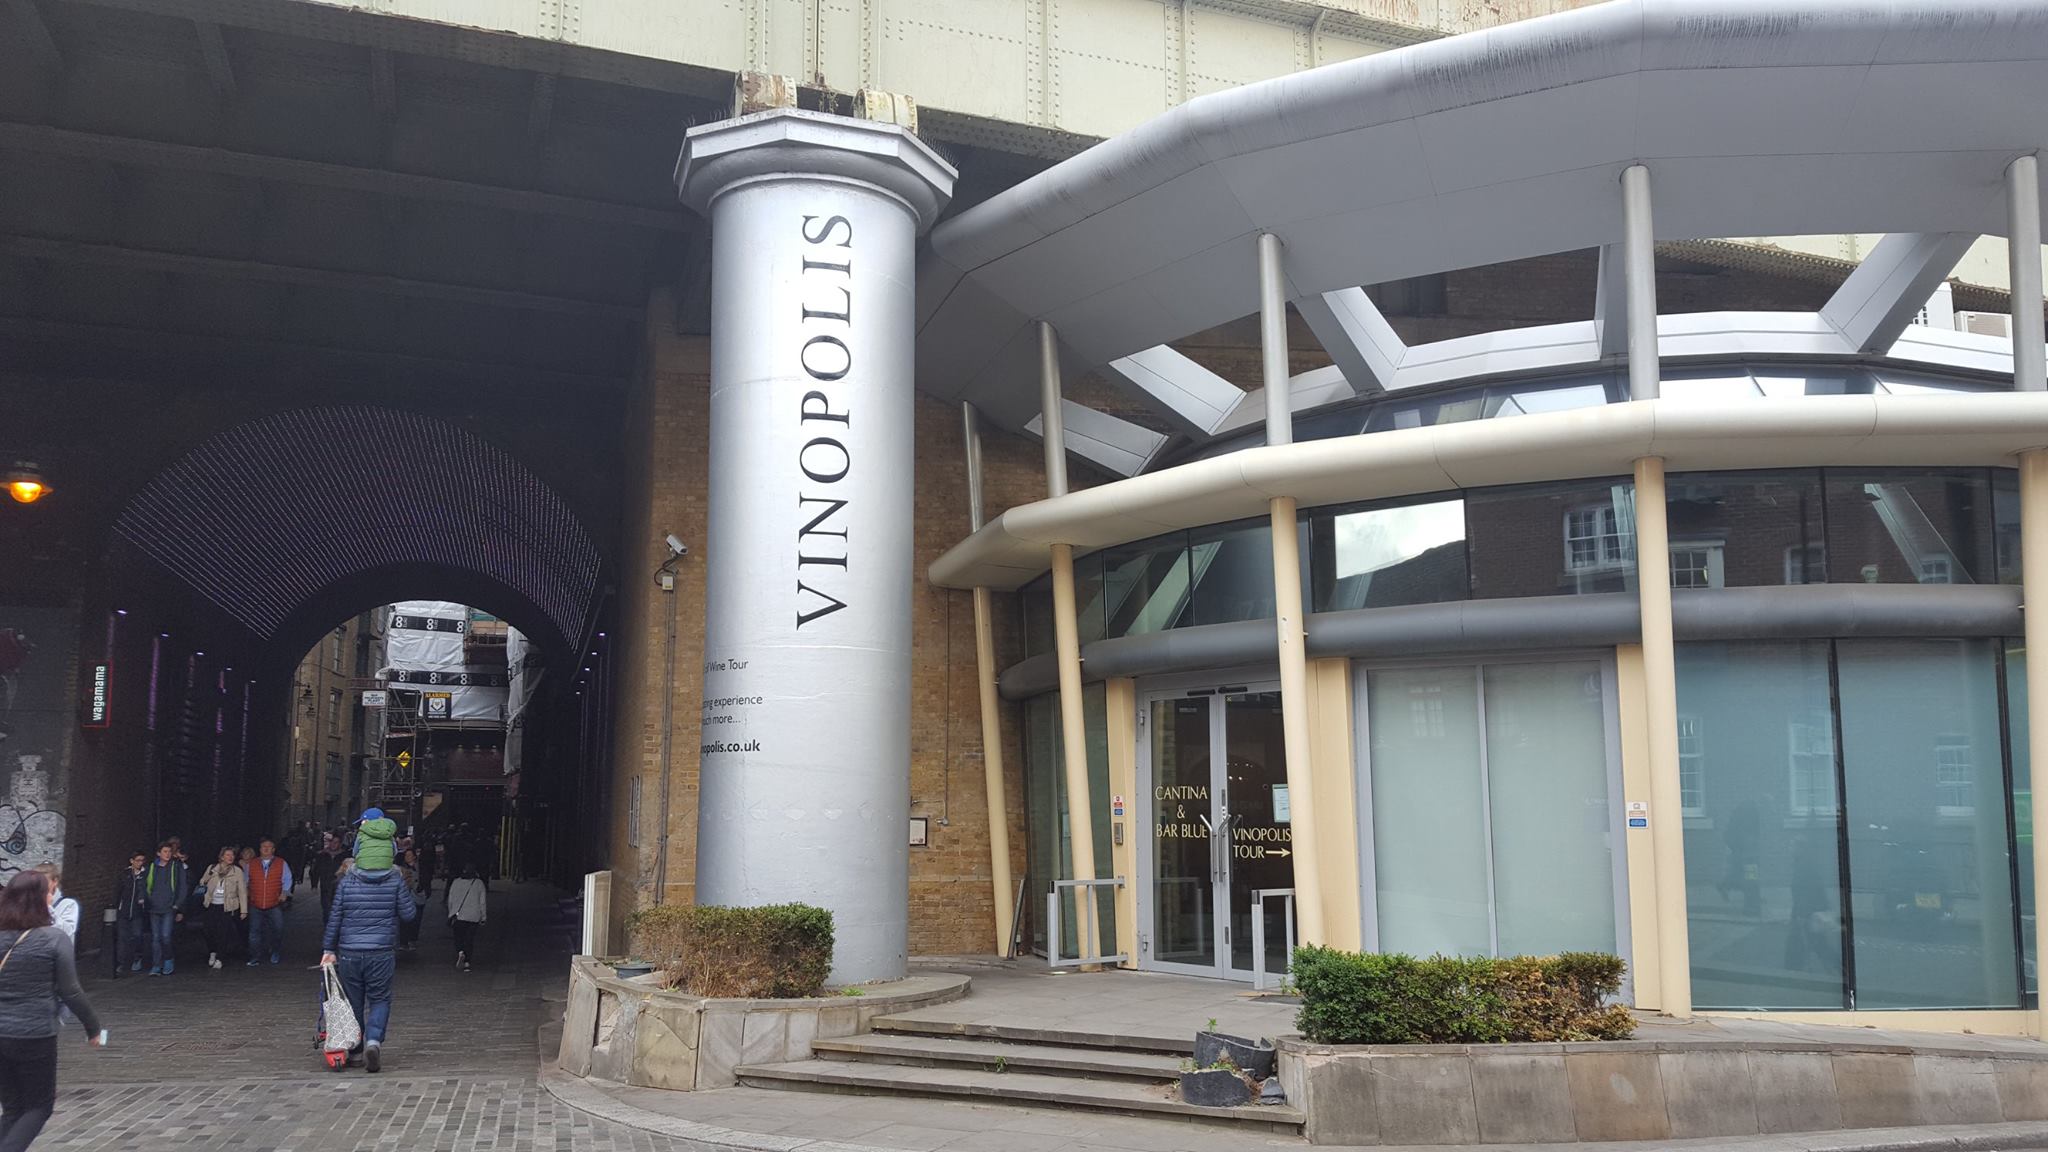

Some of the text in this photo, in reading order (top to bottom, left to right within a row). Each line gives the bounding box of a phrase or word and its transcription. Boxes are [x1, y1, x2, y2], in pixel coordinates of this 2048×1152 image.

[796, 214, 853, 631] VINOPOLIS
[728, 658, 749, 670] Tour
[92, 665, 106, 721] wagamama
[714, 695, 763, 709] experience
[1155, 785, 1208, 801] CANTINA
[1176, 804, 1186, 819] &
[1156, 823, 1208, 838] BAR BLUE
[1232, 827, 1292, 842] VINOPOLIS
[1233, 844, 1265, 859] TOUR
